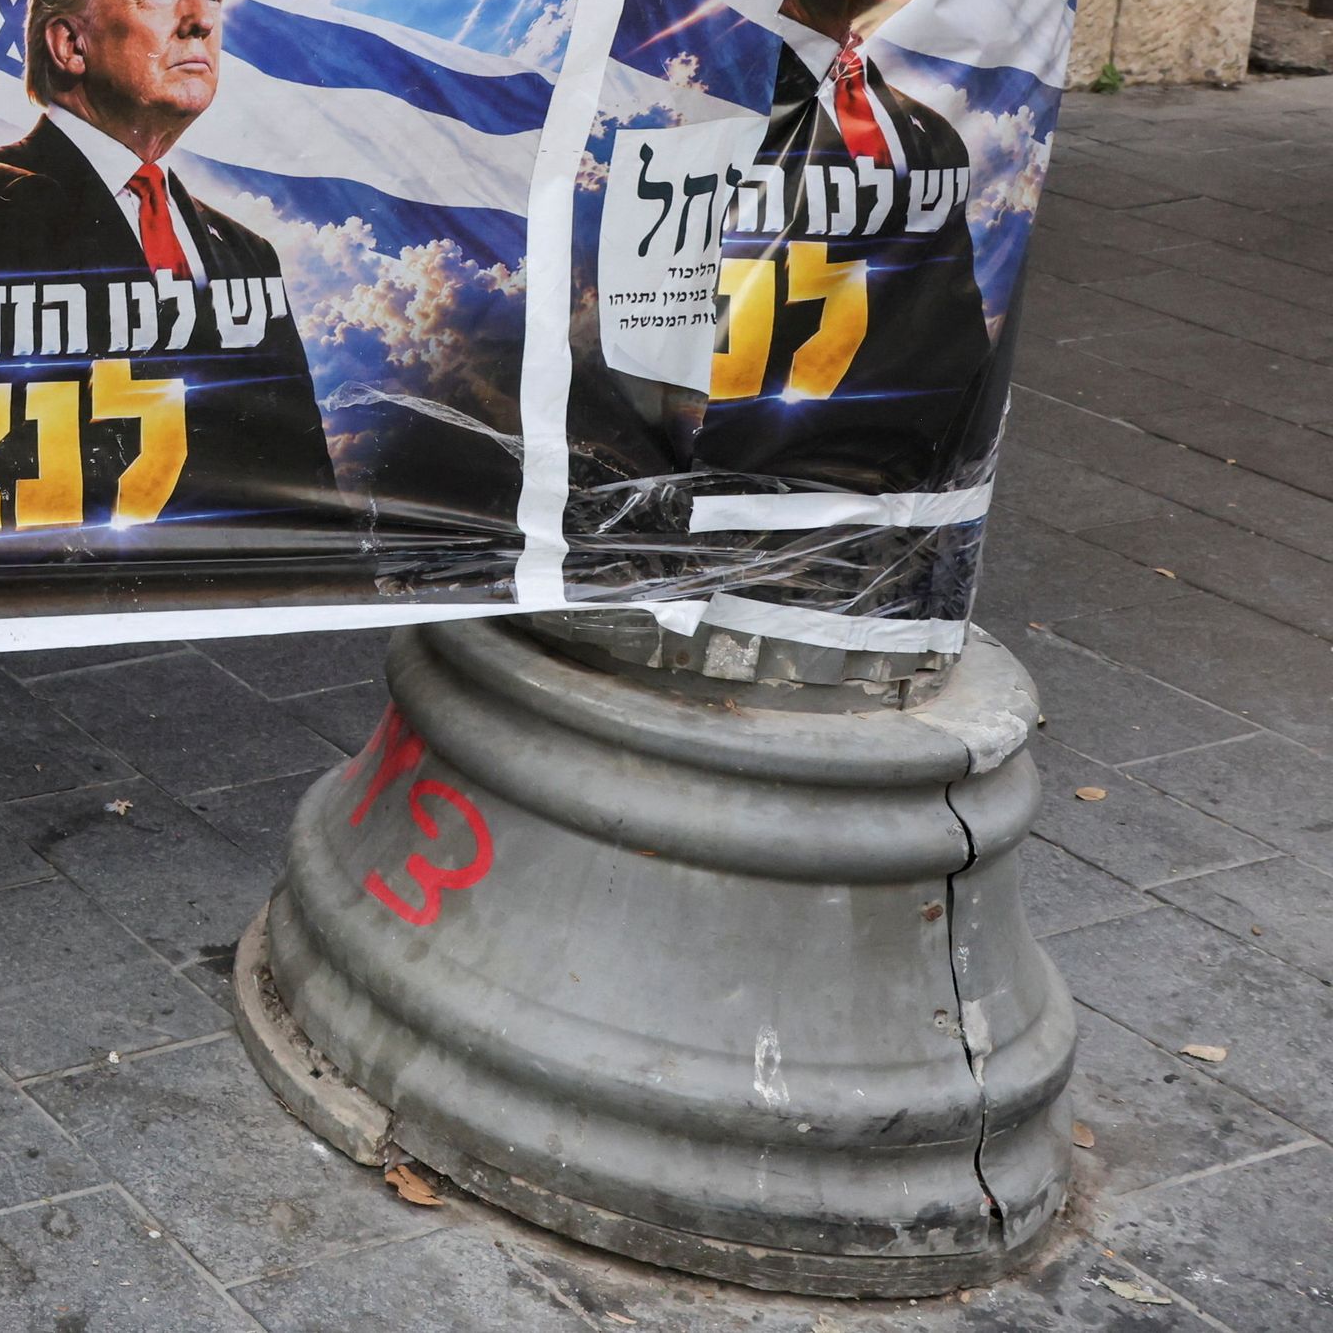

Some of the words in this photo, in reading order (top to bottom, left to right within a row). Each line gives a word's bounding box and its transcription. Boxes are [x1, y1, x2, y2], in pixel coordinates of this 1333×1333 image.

[803, 155, 895, 236] לנו
[904, 165, 971, 234] יש
[667, 263, 716, 279] הליכוד
[107, 269, 198, 352] לנו
[209, 275, 290, 349] יש
[608, 291, 657, 307] נתניהו
[663, 288, 708, 307] בנימין
[619, 314, 687, 330] הממשלה
